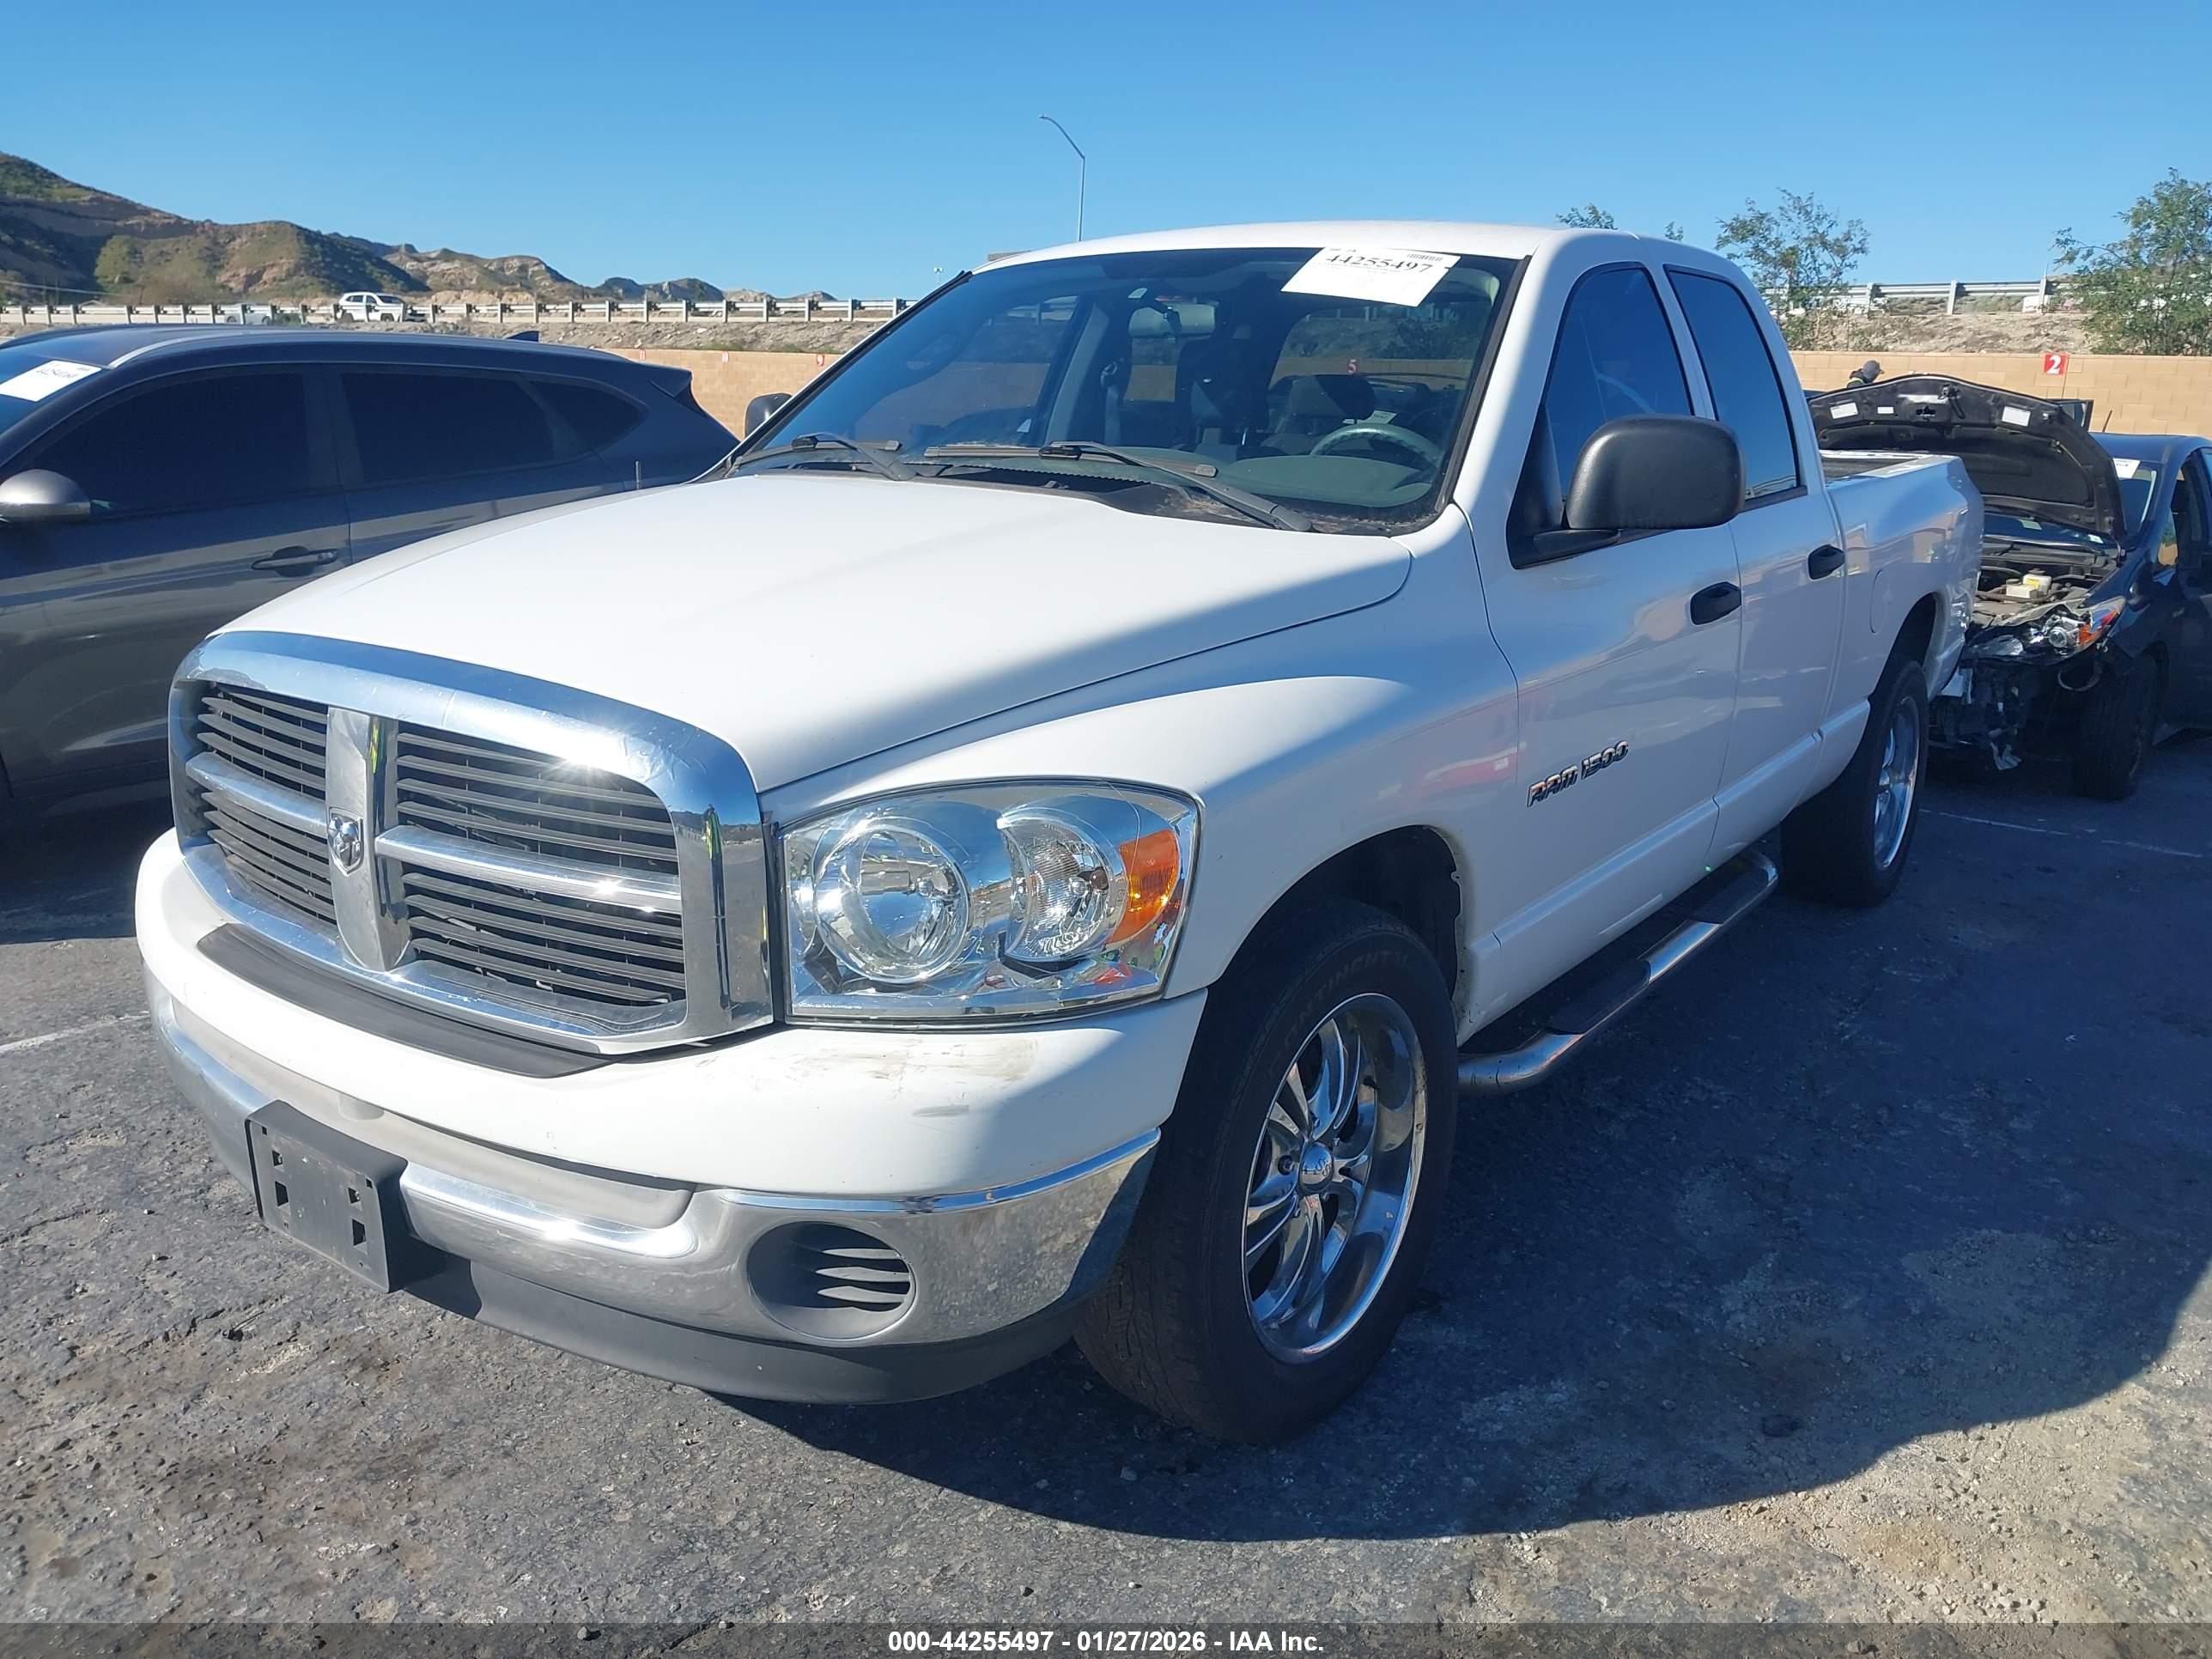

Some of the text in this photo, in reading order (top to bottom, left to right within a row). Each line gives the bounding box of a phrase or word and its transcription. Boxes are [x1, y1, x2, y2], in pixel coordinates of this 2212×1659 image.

[1325, 253, 1433, 273] 44255497
[1347, 358, 1358, 374] 5
[2046, 355, 2062, 375] 2
[1527, 740, 1630, 808] RAM 1500
